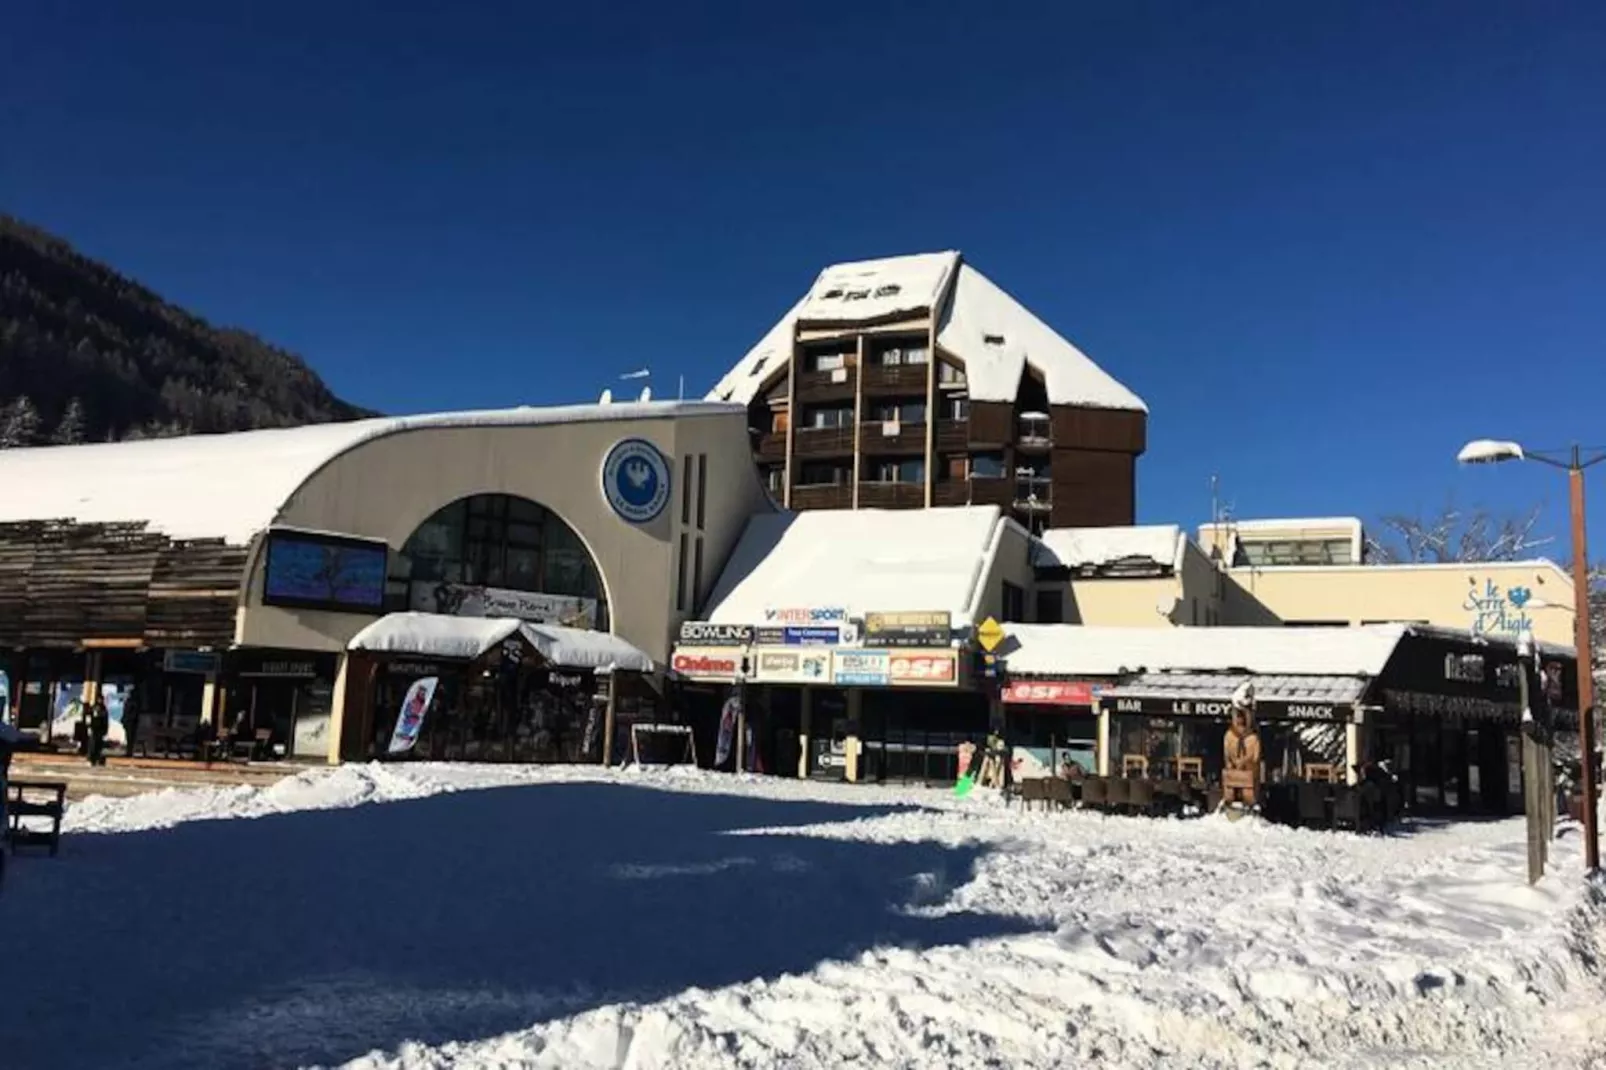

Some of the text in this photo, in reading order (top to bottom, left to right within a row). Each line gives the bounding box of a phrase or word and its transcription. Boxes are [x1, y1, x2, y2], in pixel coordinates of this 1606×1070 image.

[1462, 589, 1506, 611] Serre
[776, 607, 846, 621] INTERSPORT
[680, 624, 751, 640] BOWLING
[1117, 698, 1143, 713] BAR
[1171, 701, 1192, 715] LE
[1286, 704, 1334, 719] SNACK
